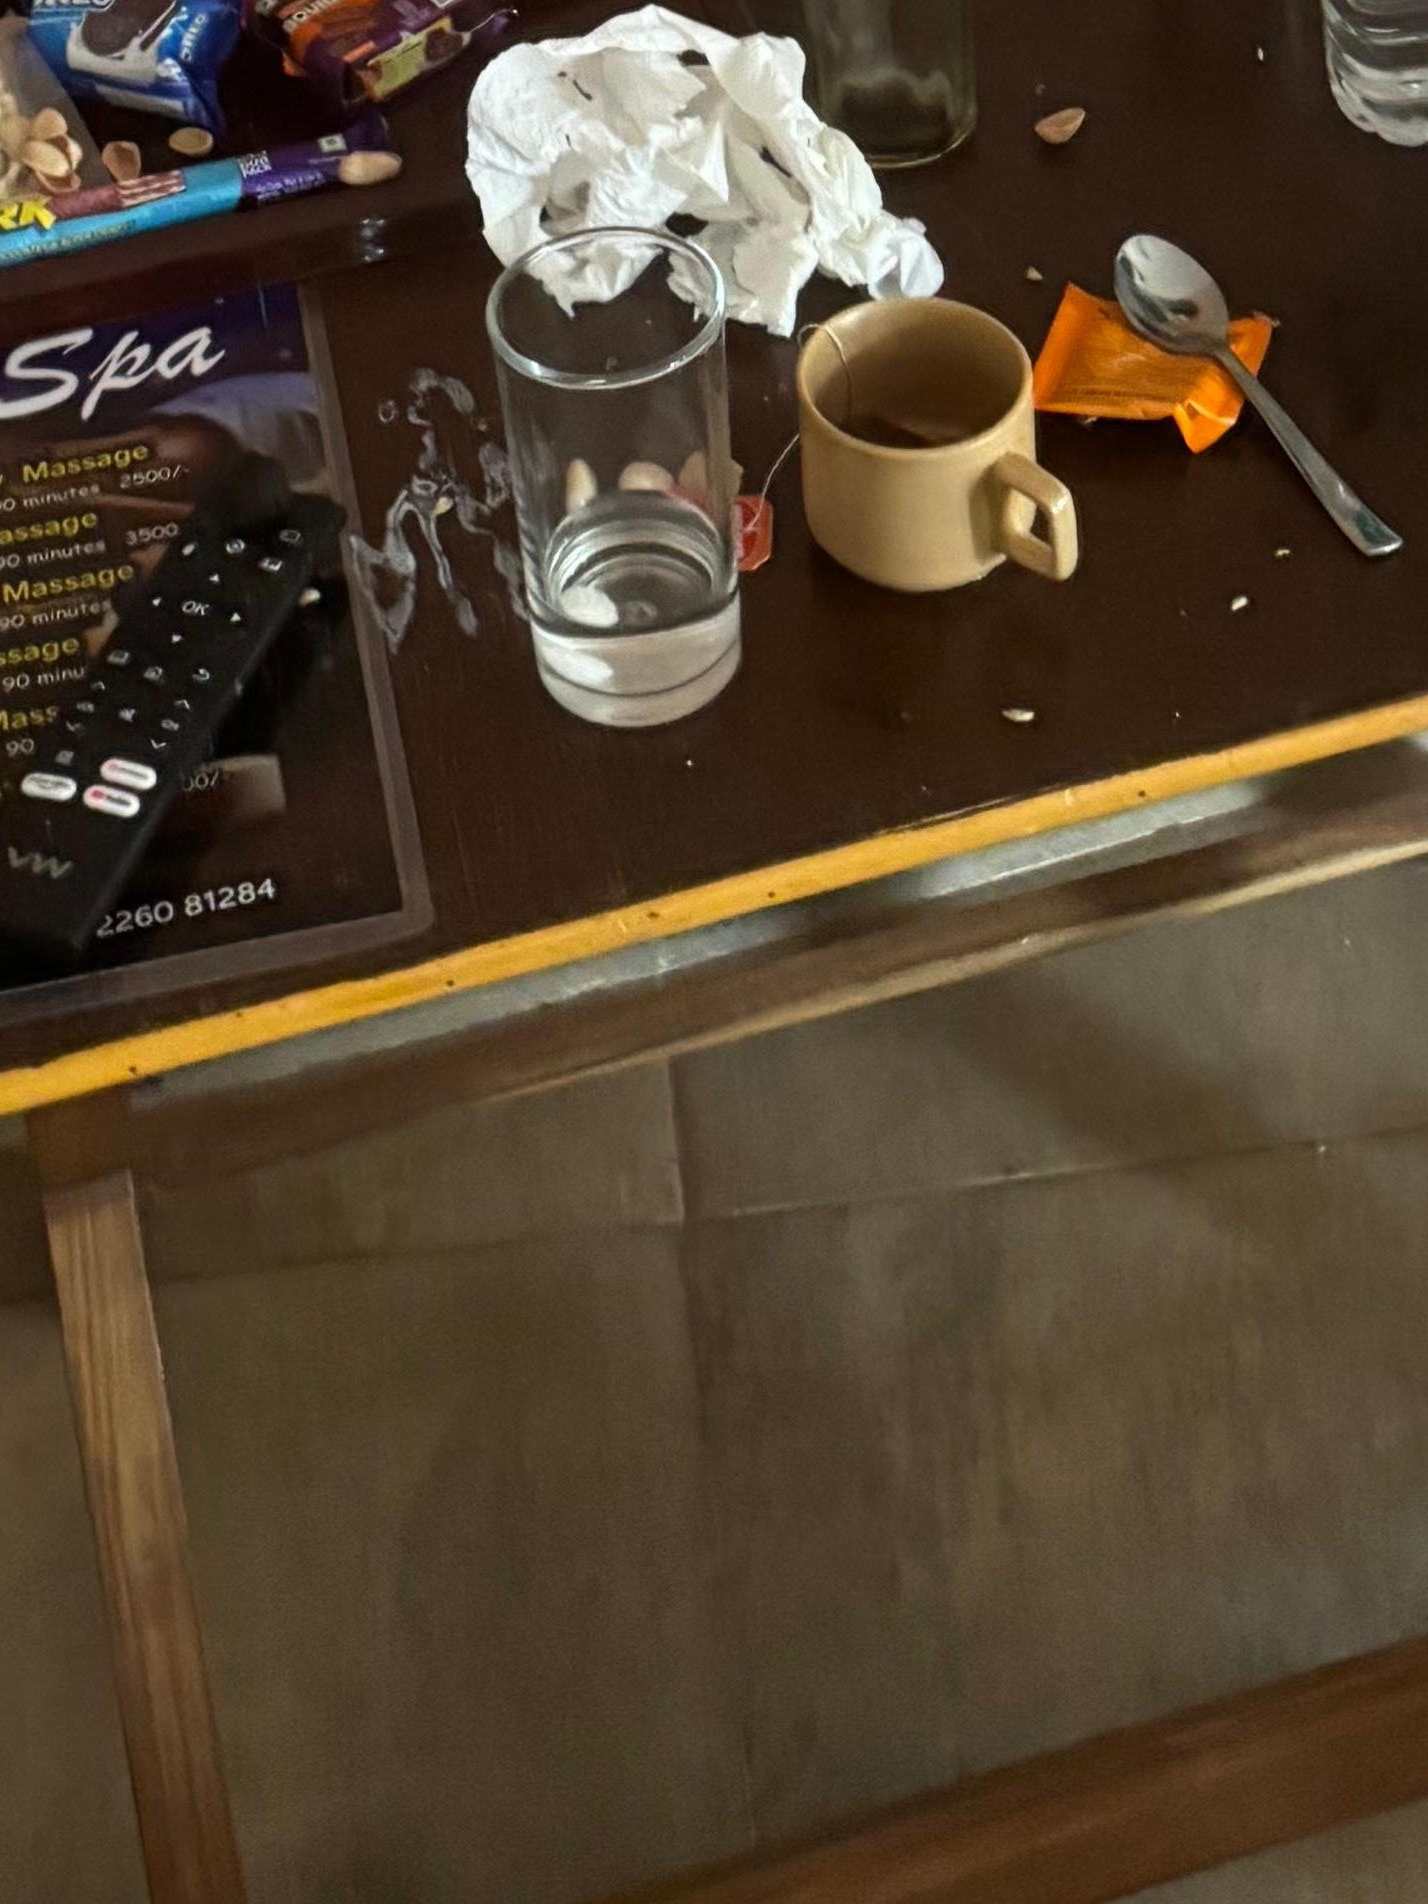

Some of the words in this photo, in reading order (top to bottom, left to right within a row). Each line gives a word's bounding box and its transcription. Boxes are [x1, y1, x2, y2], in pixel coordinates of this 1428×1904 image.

[22, 445, 150, 483] Massage
[23, 482, 100, 509] minutes
[26, 539, 106, 565] minutes
[125, 522, 180, 546] 3500
[1, 564, 135, 605] Massage
[31, 598, 112, 626] minutes
[181, 599, 210, 616] OK
[2, 674, 31, 694] 90
[37, 665, 85, 687] minu
[6, 739, 35, 758] 90
[95, 900, 174, 939] 2260
[184, 878, 276, 918] 81284
